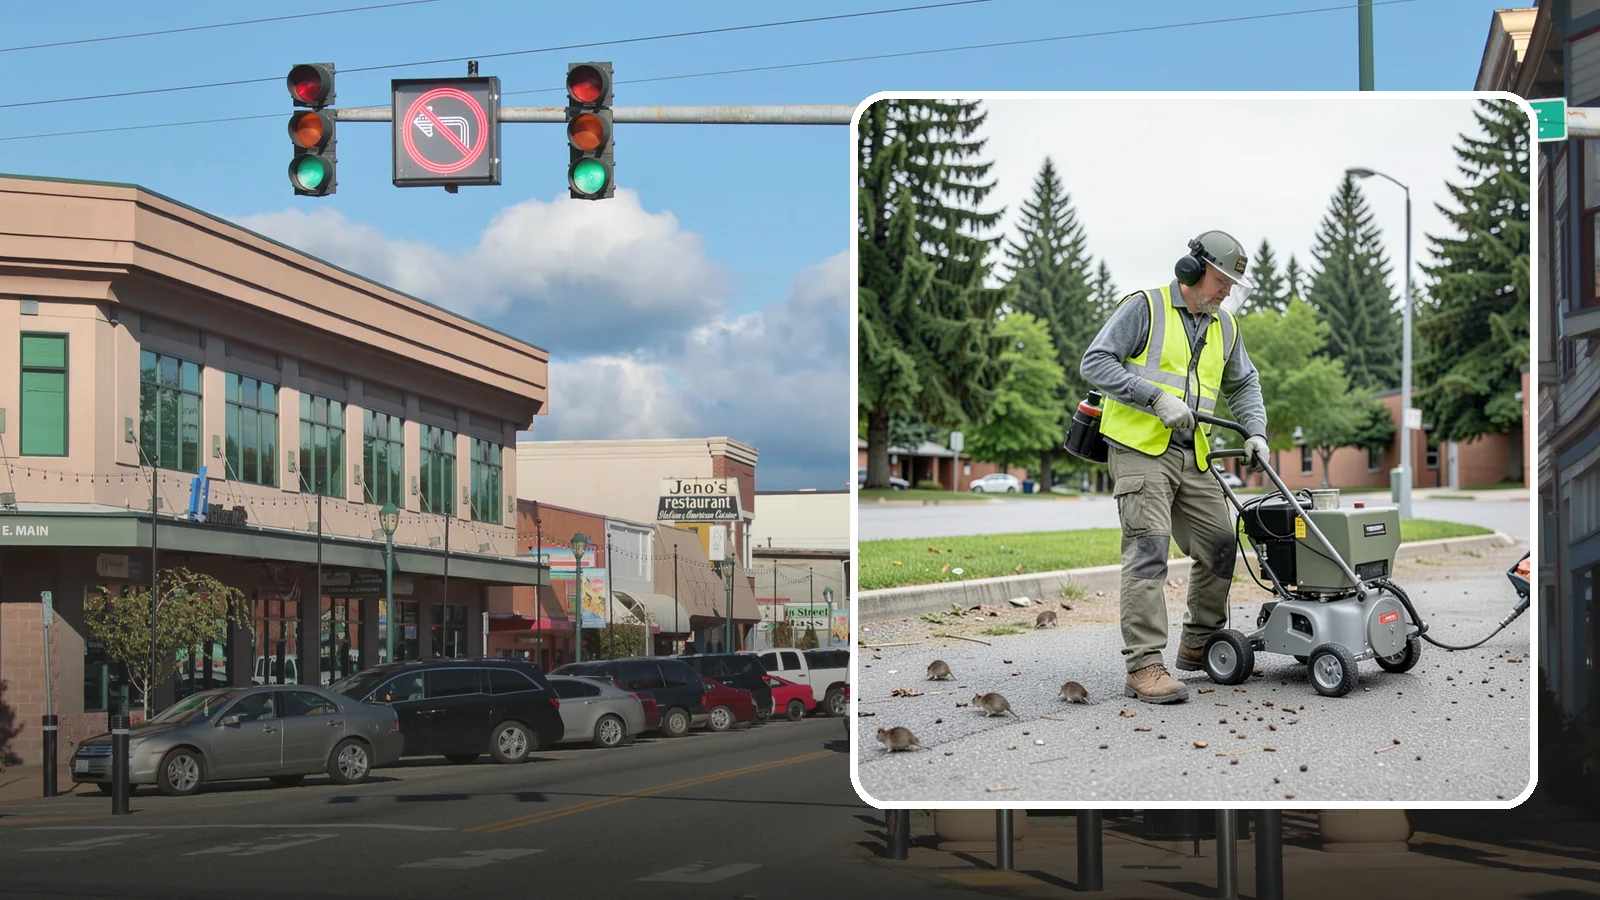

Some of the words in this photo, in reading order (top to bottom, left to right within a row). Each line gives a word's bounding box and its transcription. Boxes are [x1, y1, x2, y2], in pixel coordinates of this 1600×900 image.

[669, 480, 728, 494] Jeno's
[665, 496, 731, 509] restaurant
[658, 510, 681, 520] Italian
[686, 510, 715, 519] American
[715, 509, 737, 519] Cuisine
[2, 525, 13, 536] E.
[15, 525, 49, 536] MAIN
[797, 607, 829, 617] Street
[790, 619, 824, 627] lass
